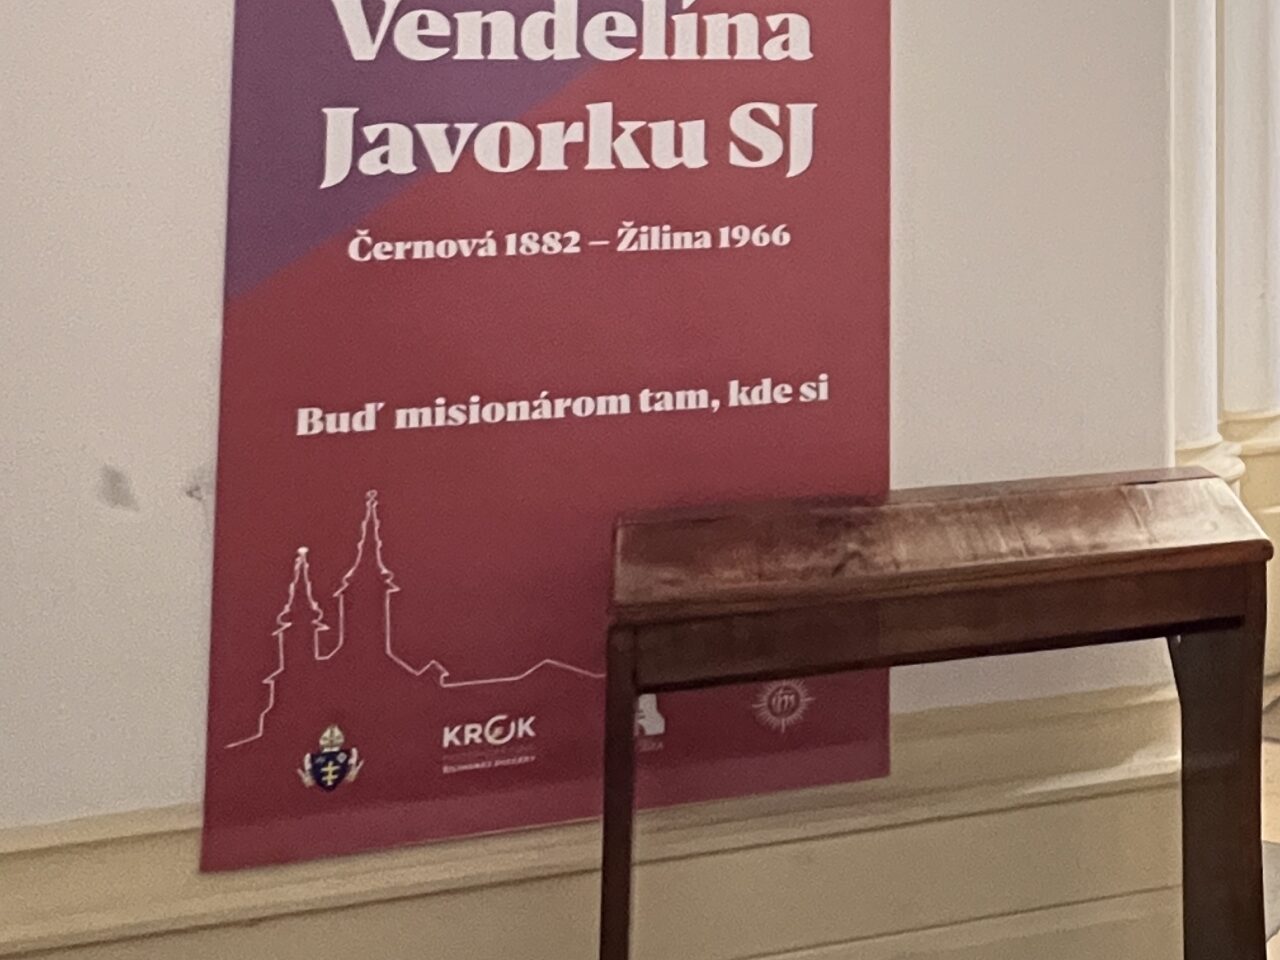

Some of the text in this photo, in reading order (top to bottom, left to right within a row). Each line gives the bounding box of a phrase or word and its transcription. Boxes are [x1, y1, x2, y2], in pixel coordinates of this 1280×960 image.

[319, 101, 818, 189] Javorku SJ
[348, 228, 497, 262] Černová
[505, 230, 581, 256] 1882
[617, 220, 712, 252] Žilina
[719, 223, 791, 249] 1966
[296, 373, 829, 436] Buď misionárom tam, kde si
[443, 714, 536, 748] KROK
